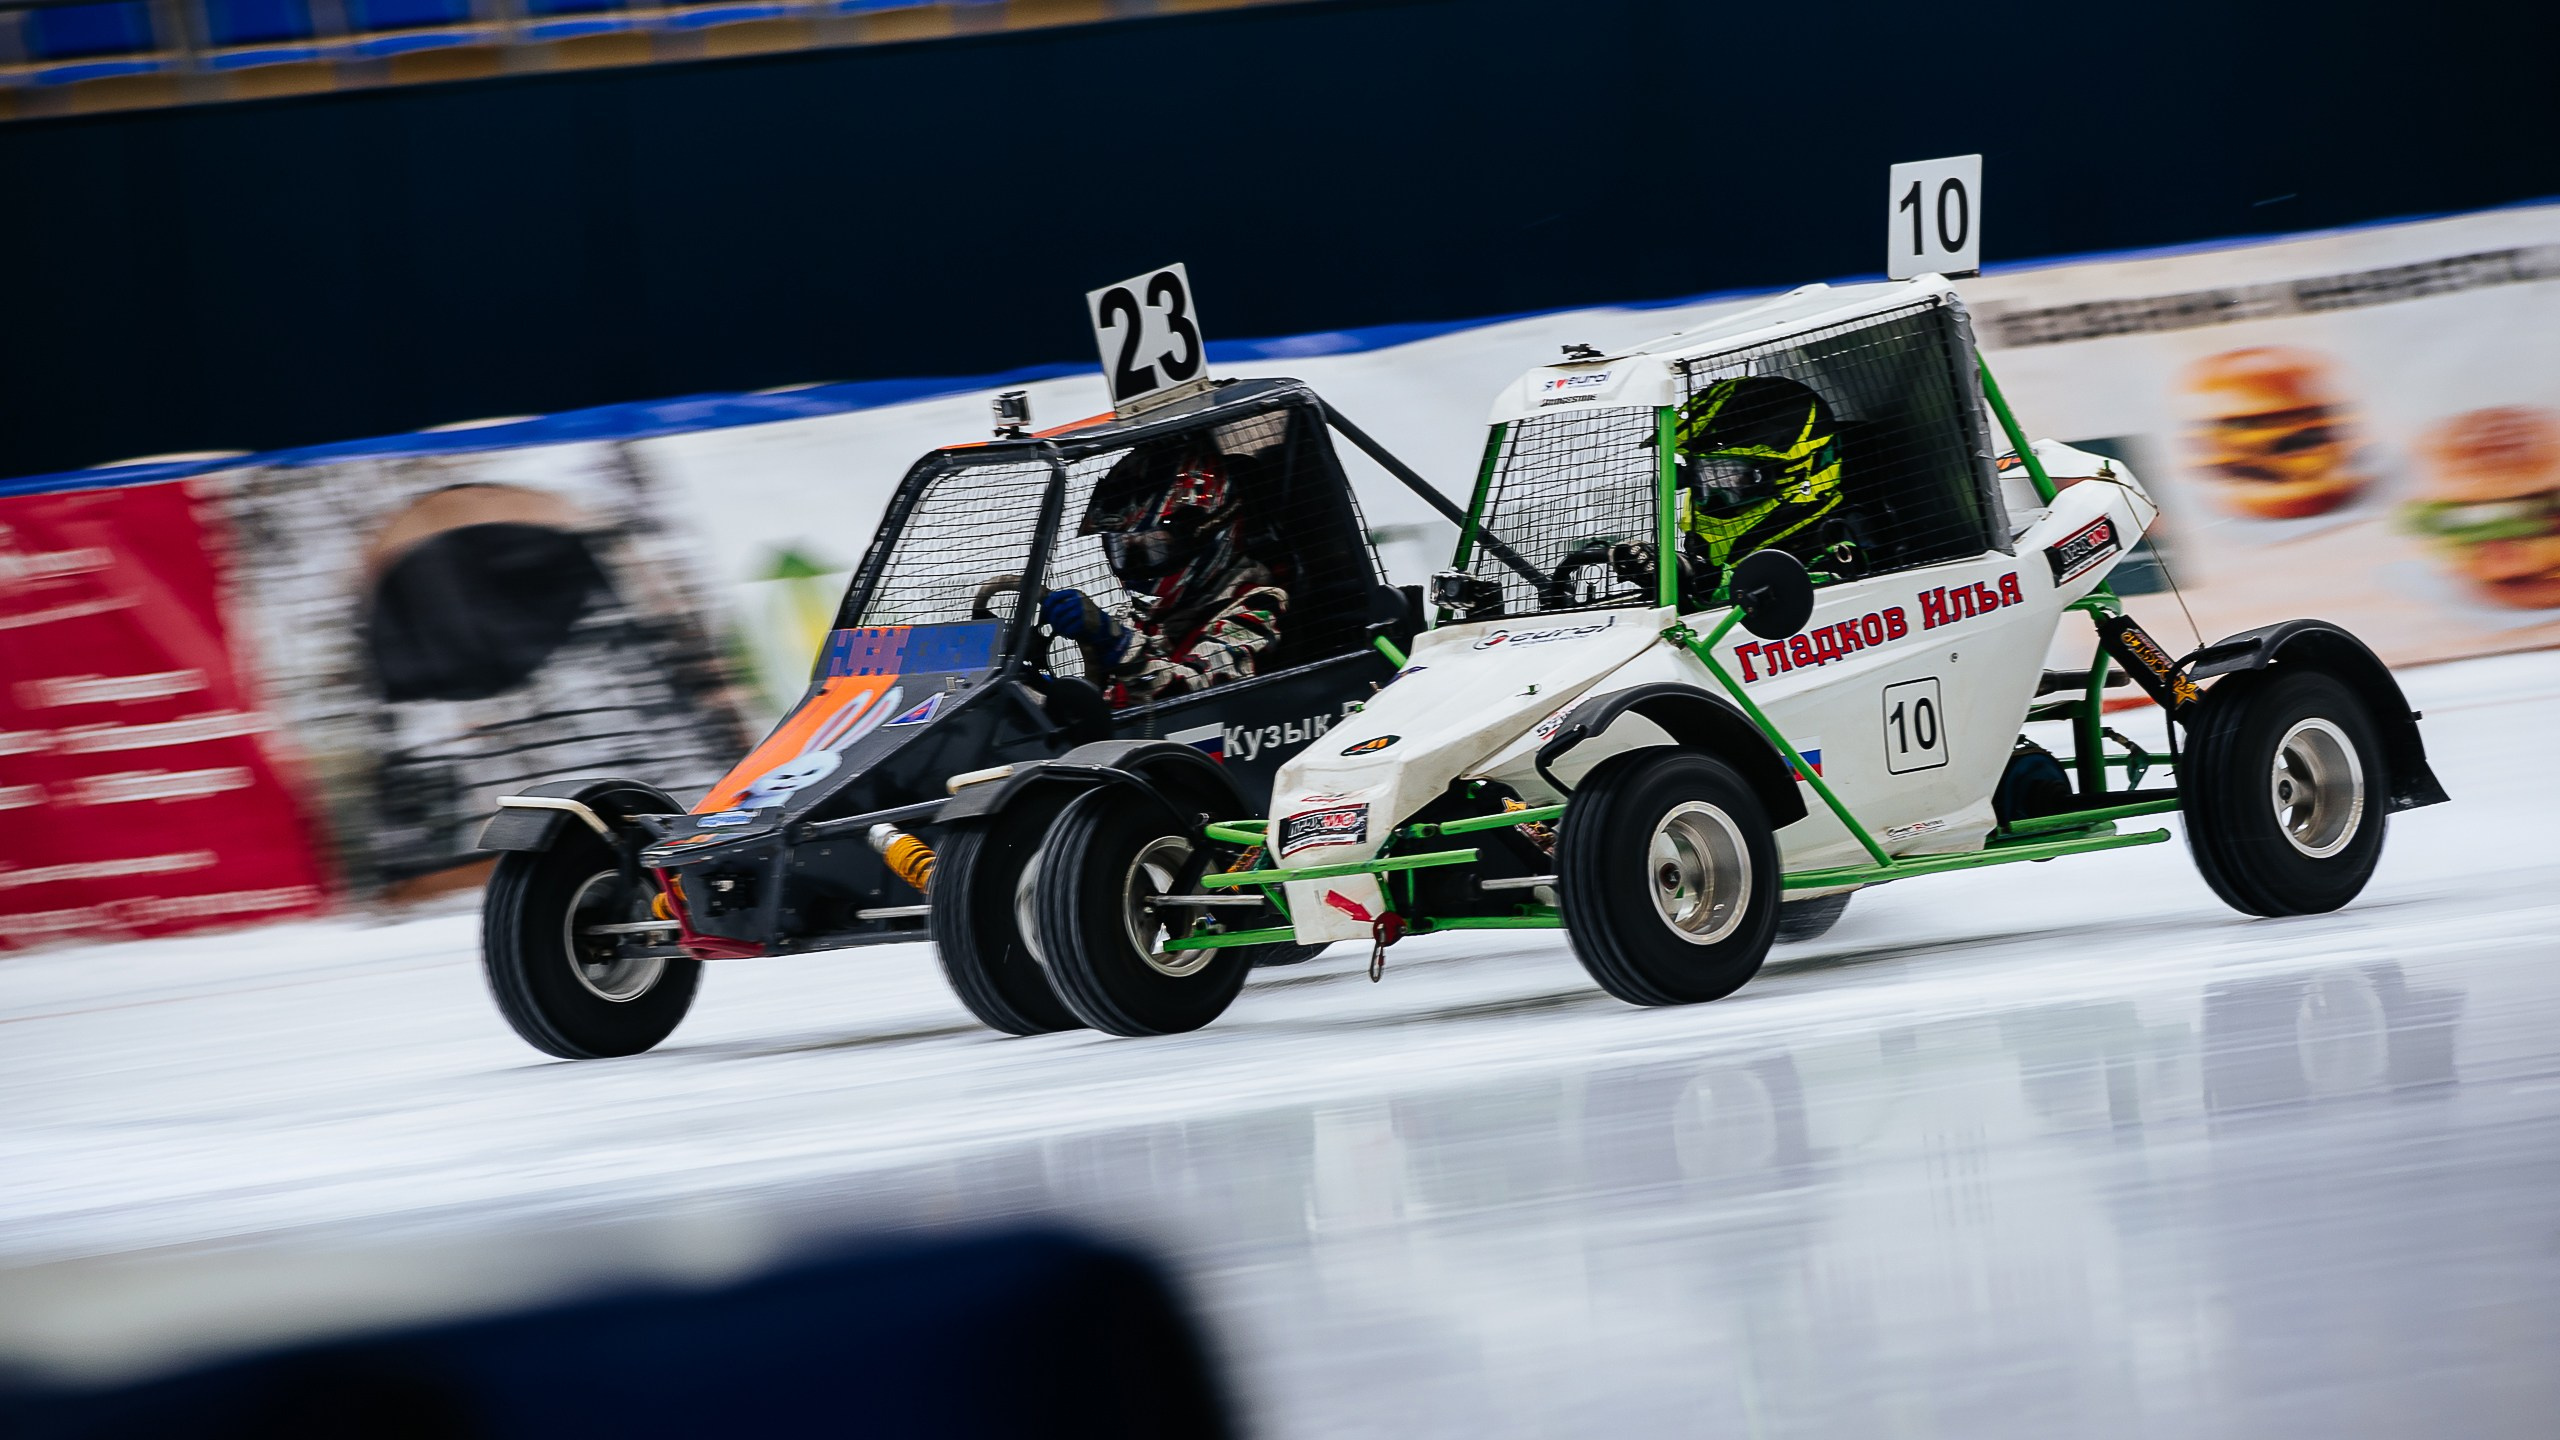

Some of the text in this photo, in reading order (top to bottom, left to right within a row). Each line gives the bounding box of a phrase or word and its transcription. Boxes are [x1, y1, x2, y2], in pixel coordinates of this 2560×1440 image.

[1899, 177, 1968, 256] 10
[1100, 271, 1201, 402] 23
[1733, 572, 2025, 684] Гладков Илья
[1222, 713, 1332, 762] Кузык
[1889, 697, 1937, 754] 10
